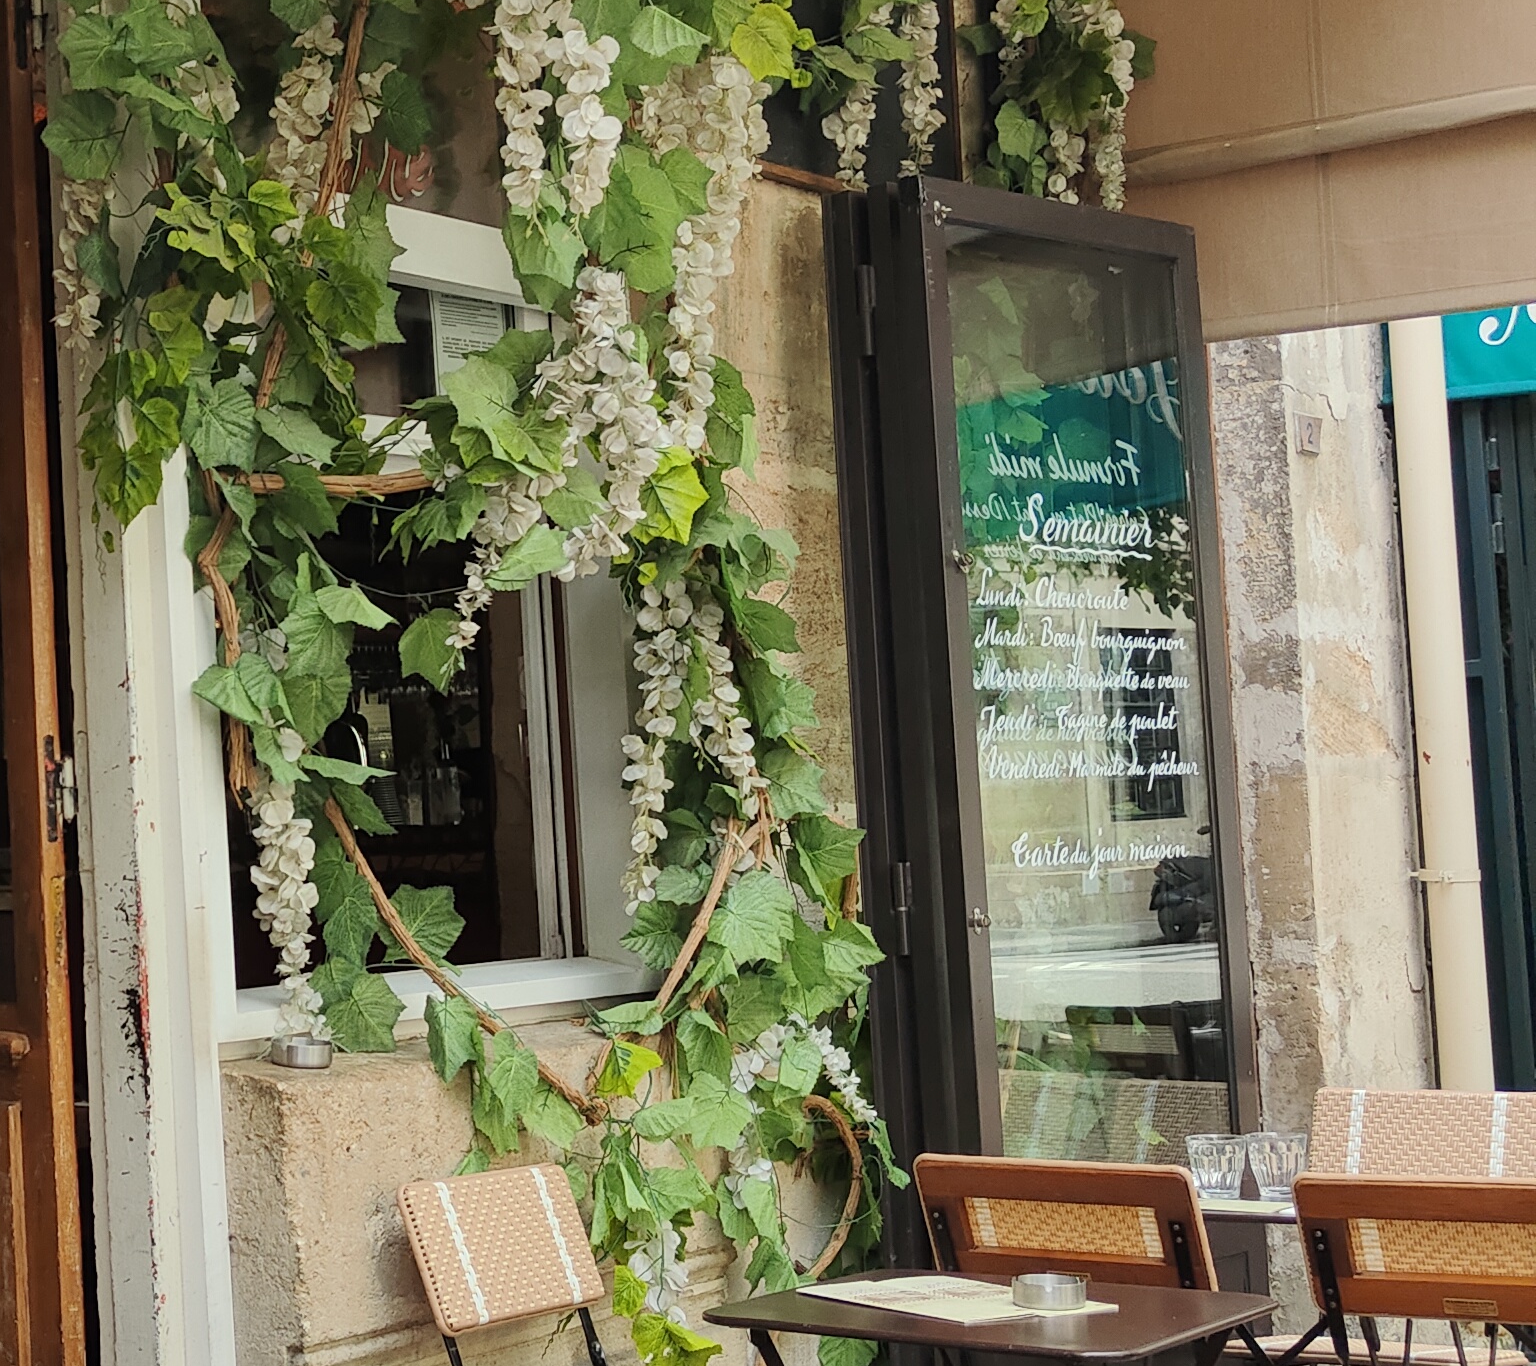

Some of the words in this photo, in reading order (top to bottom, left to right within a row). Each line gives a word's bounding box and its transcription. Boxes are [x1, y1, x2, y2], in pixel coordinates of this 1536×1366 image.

[1019, 492, 1157, 548] Semainier
[1035, 574, 1130, 610] Choucroute
[1090, 619, 1186, 665] bourguignon
[1140, 672, 1155, 689] de
[1158, 675, 1191, 689] veau
[1110, 708, 1128, 729] de
[1129, 702, 1179, 744] poulet
[1068, 753, 1125, 778] Marmite
[1127, 758, 1145, 776] du
[1146, 750, 1200, 792] pêcheur
[1070, 839, 1090, 864] du
[1089, 827, 1124, 879] jour
[1129, 835, 1190, 861] maison
